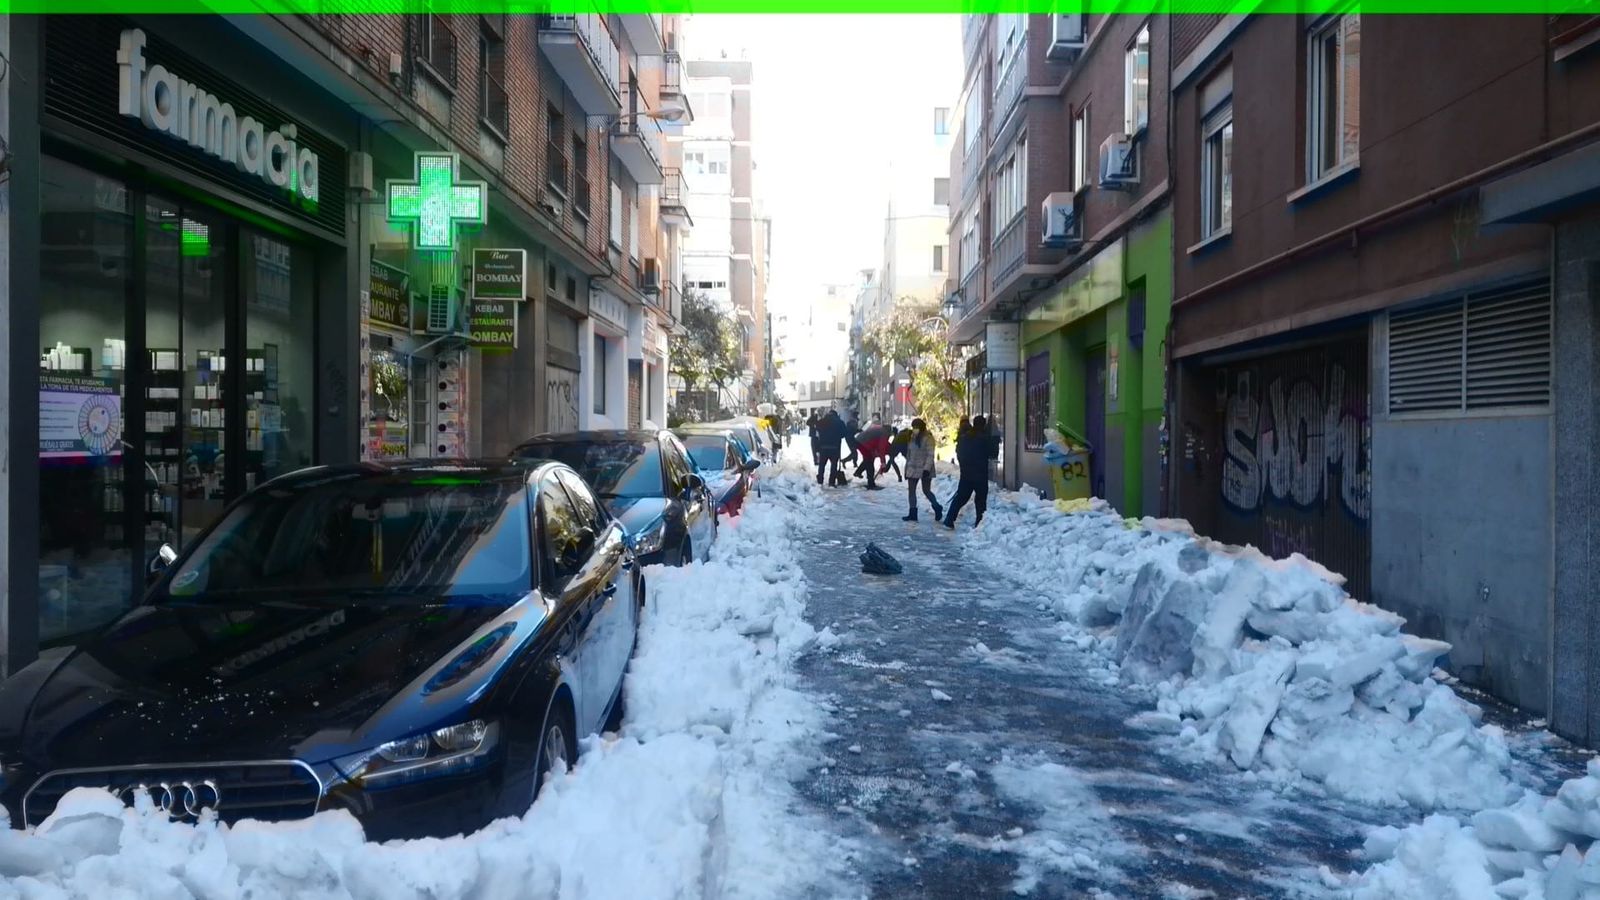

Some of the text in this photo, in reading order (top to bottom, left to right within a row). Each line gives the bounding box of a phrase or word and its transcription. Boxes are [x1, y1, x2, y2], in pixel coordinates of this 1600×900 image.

[116, 28, 319, 203] farmacia
[476, 273, 522, 283] BOMBAY
[475, 304, 504, 313] KEBAB
[1061, 461, 1087, 481] 82
